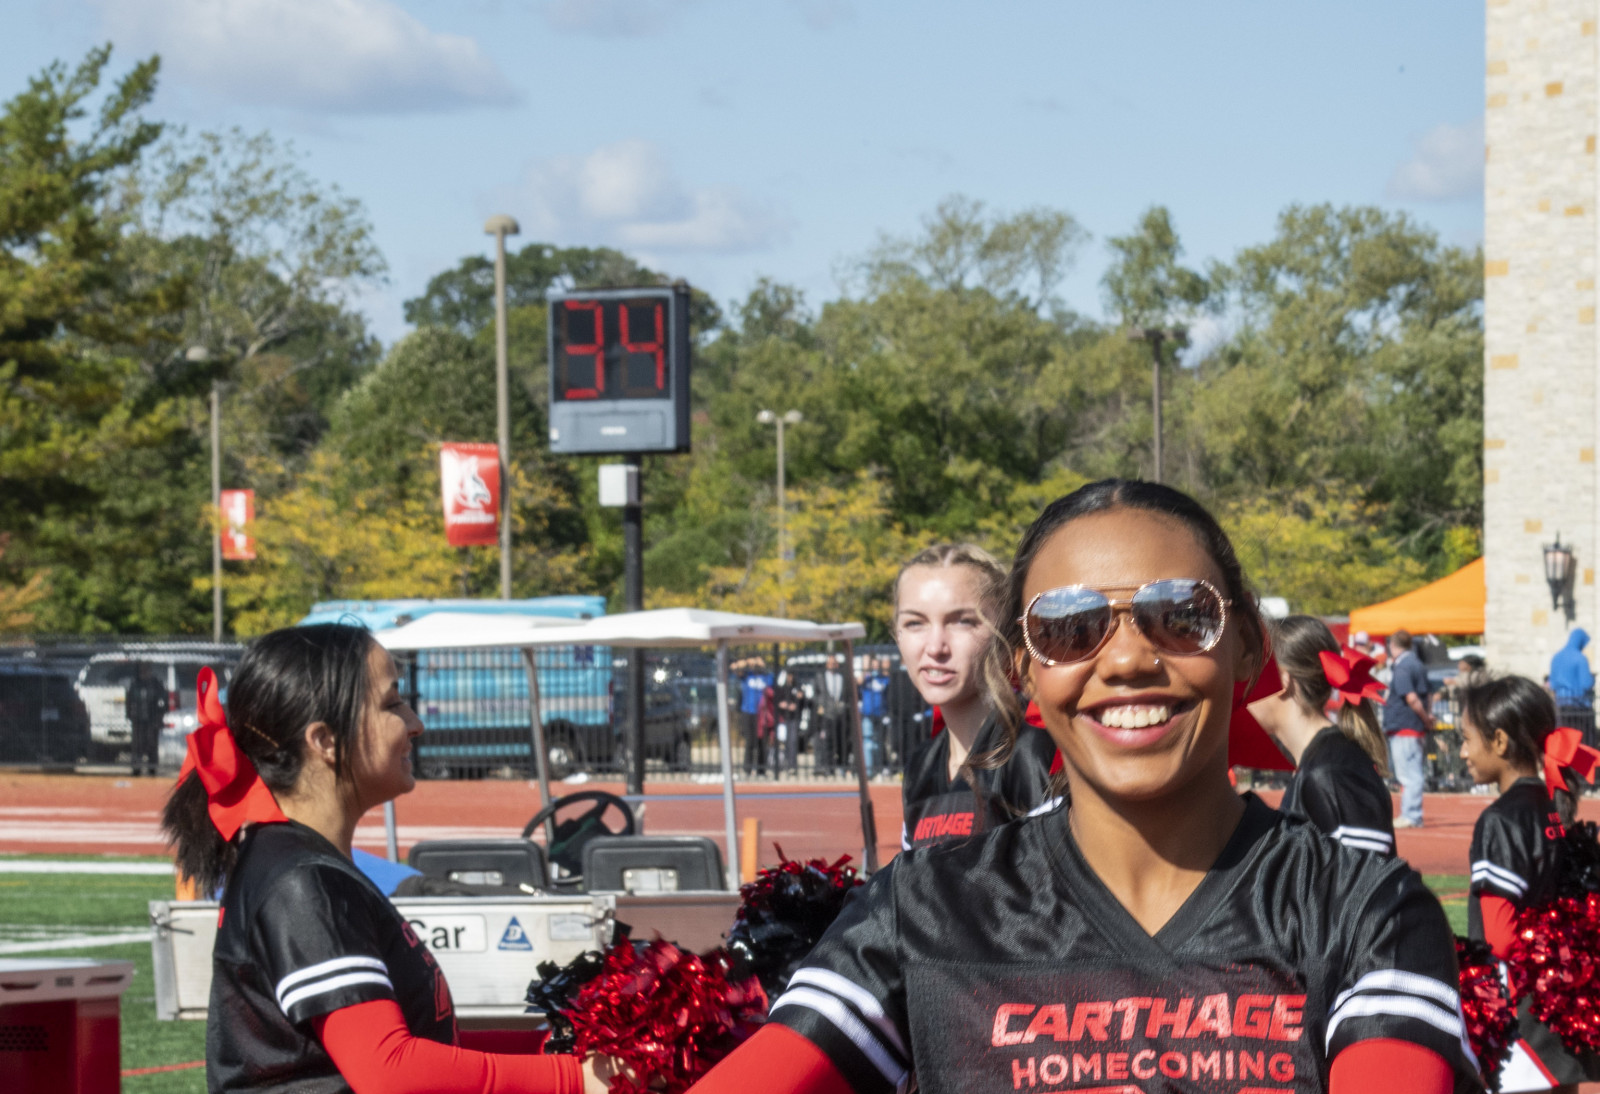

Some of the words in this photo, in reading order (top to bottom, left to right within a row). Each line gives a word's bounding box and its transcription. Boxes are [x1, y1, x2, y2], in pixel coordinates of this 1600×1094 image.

[564, 299, 664, 399] 34
[914, 812, 975, 841] ARTHAGE
[991, 993, 1307, 1047] CARTHAGE
[1012, 1049, 1296, 1090] HOMECOMING
